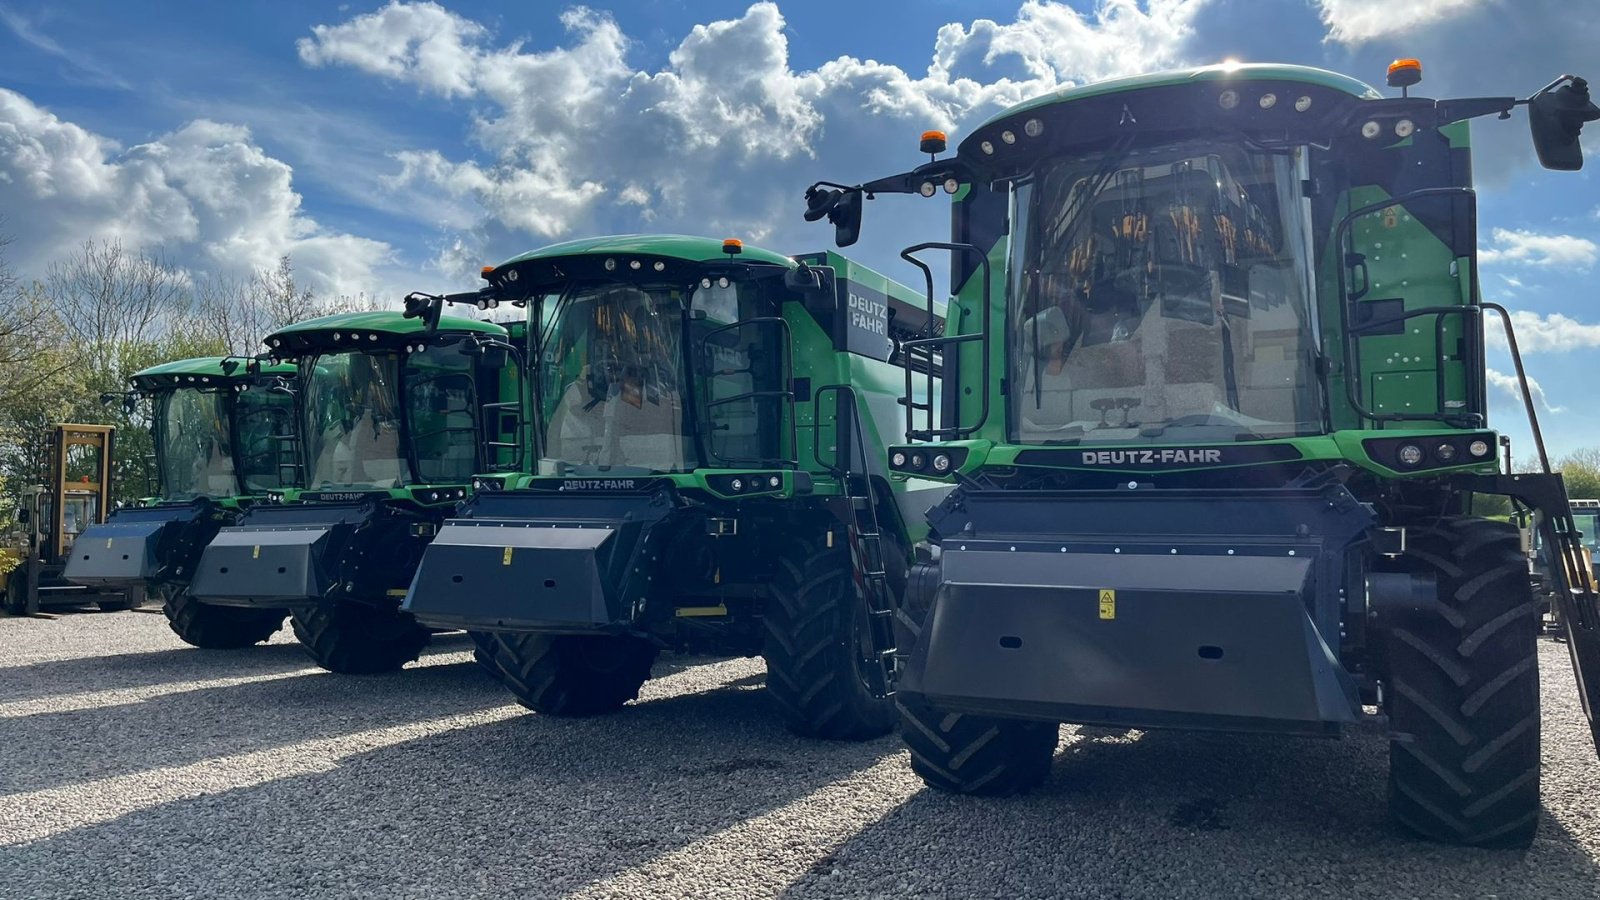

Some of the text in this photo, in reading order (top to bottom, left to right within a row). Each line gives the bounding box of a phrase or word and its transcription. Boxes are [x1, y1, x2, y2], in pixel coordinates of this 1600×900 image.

[849, 292, 887, 320] DEUTZ
[852, 311, 884, 336] FAHR
[1082, 449, 1221, 465] DEUTZ-FAHR
[564, 480, 635, 490] DEUTZ-FAHR
